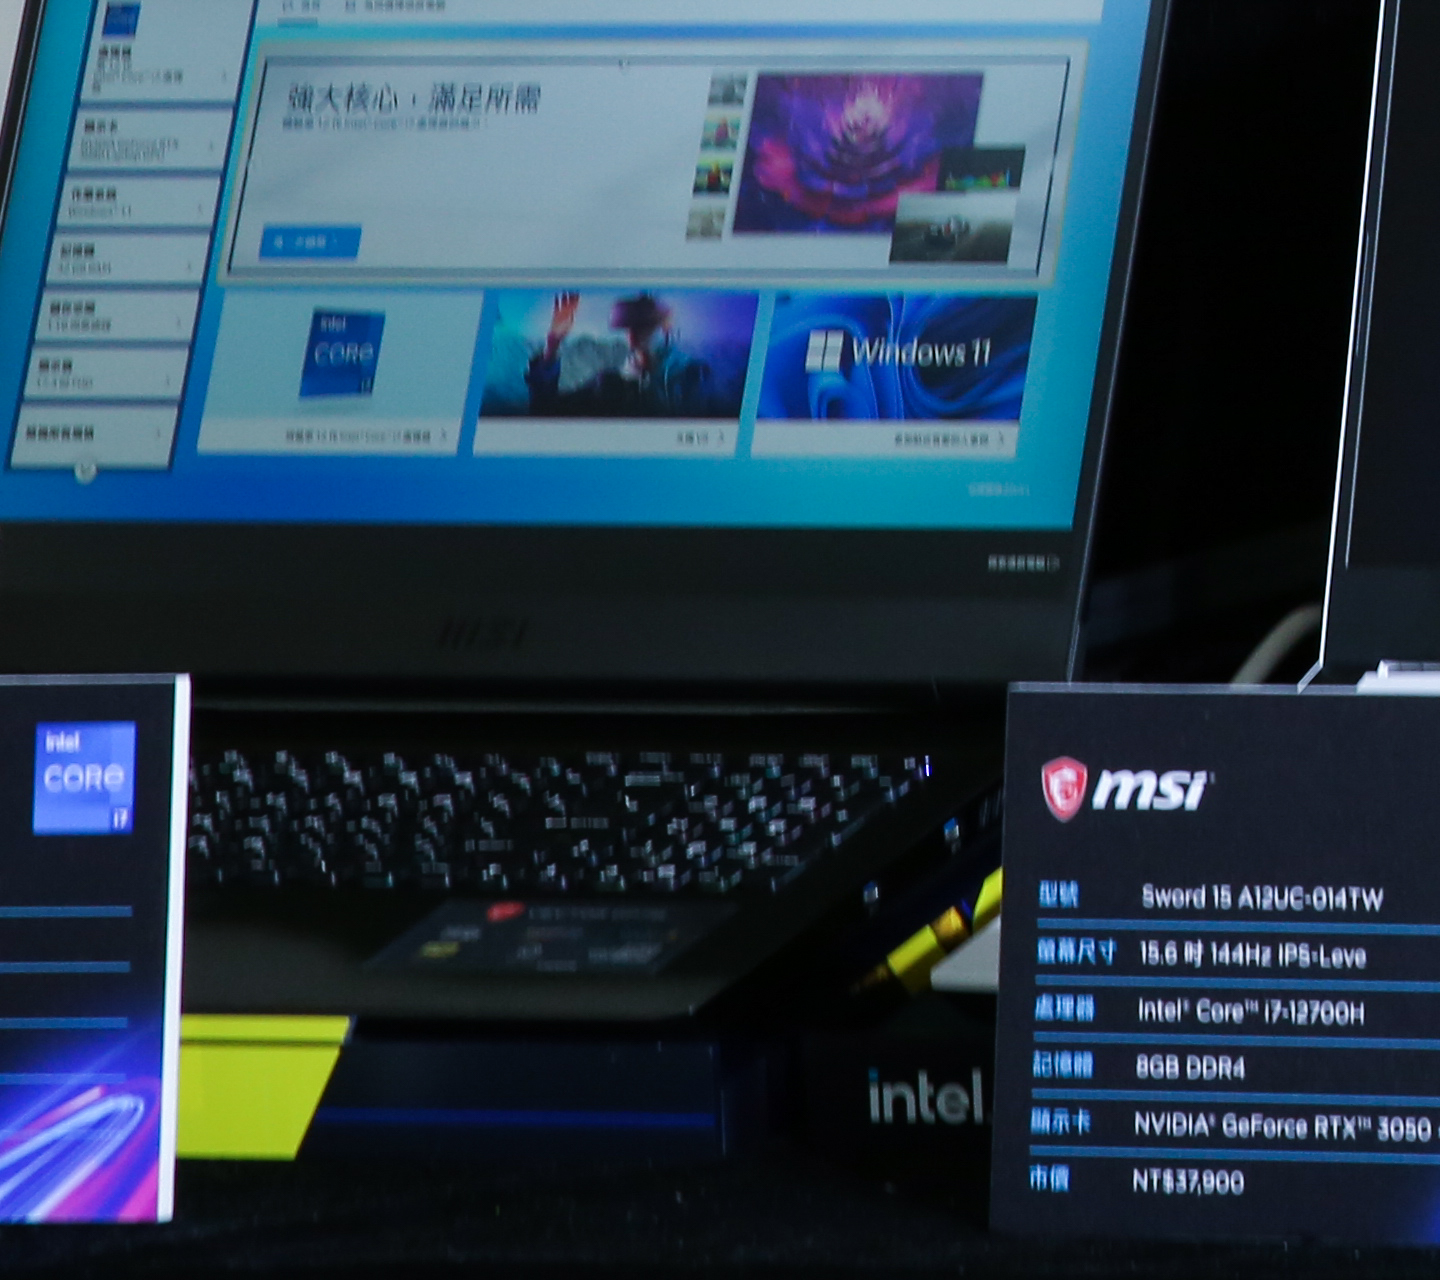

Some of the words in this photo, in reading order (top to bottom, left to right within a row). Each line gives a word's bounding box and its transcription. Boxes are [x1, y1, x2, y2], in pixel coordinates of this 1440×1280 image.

[851, 338, 965, 368] Windows
[970, 338, 991, 368] 11
[1093, 769, 1208, 811] msi
[1143, 883, 1206, 910] Sword
[1213, 885, 1232, 910] 15
[1140, 942, 1178, 967] 15.6
[1210, 943, 1271, 968] 144Hz
[1136, 1054, 1180, 1080] 8GB
[1186, 1055, 1245, 1080] DDR4
[869, 1067, 983, 1124] intel
[1222, 1112, 1308, 1139] GeForce
